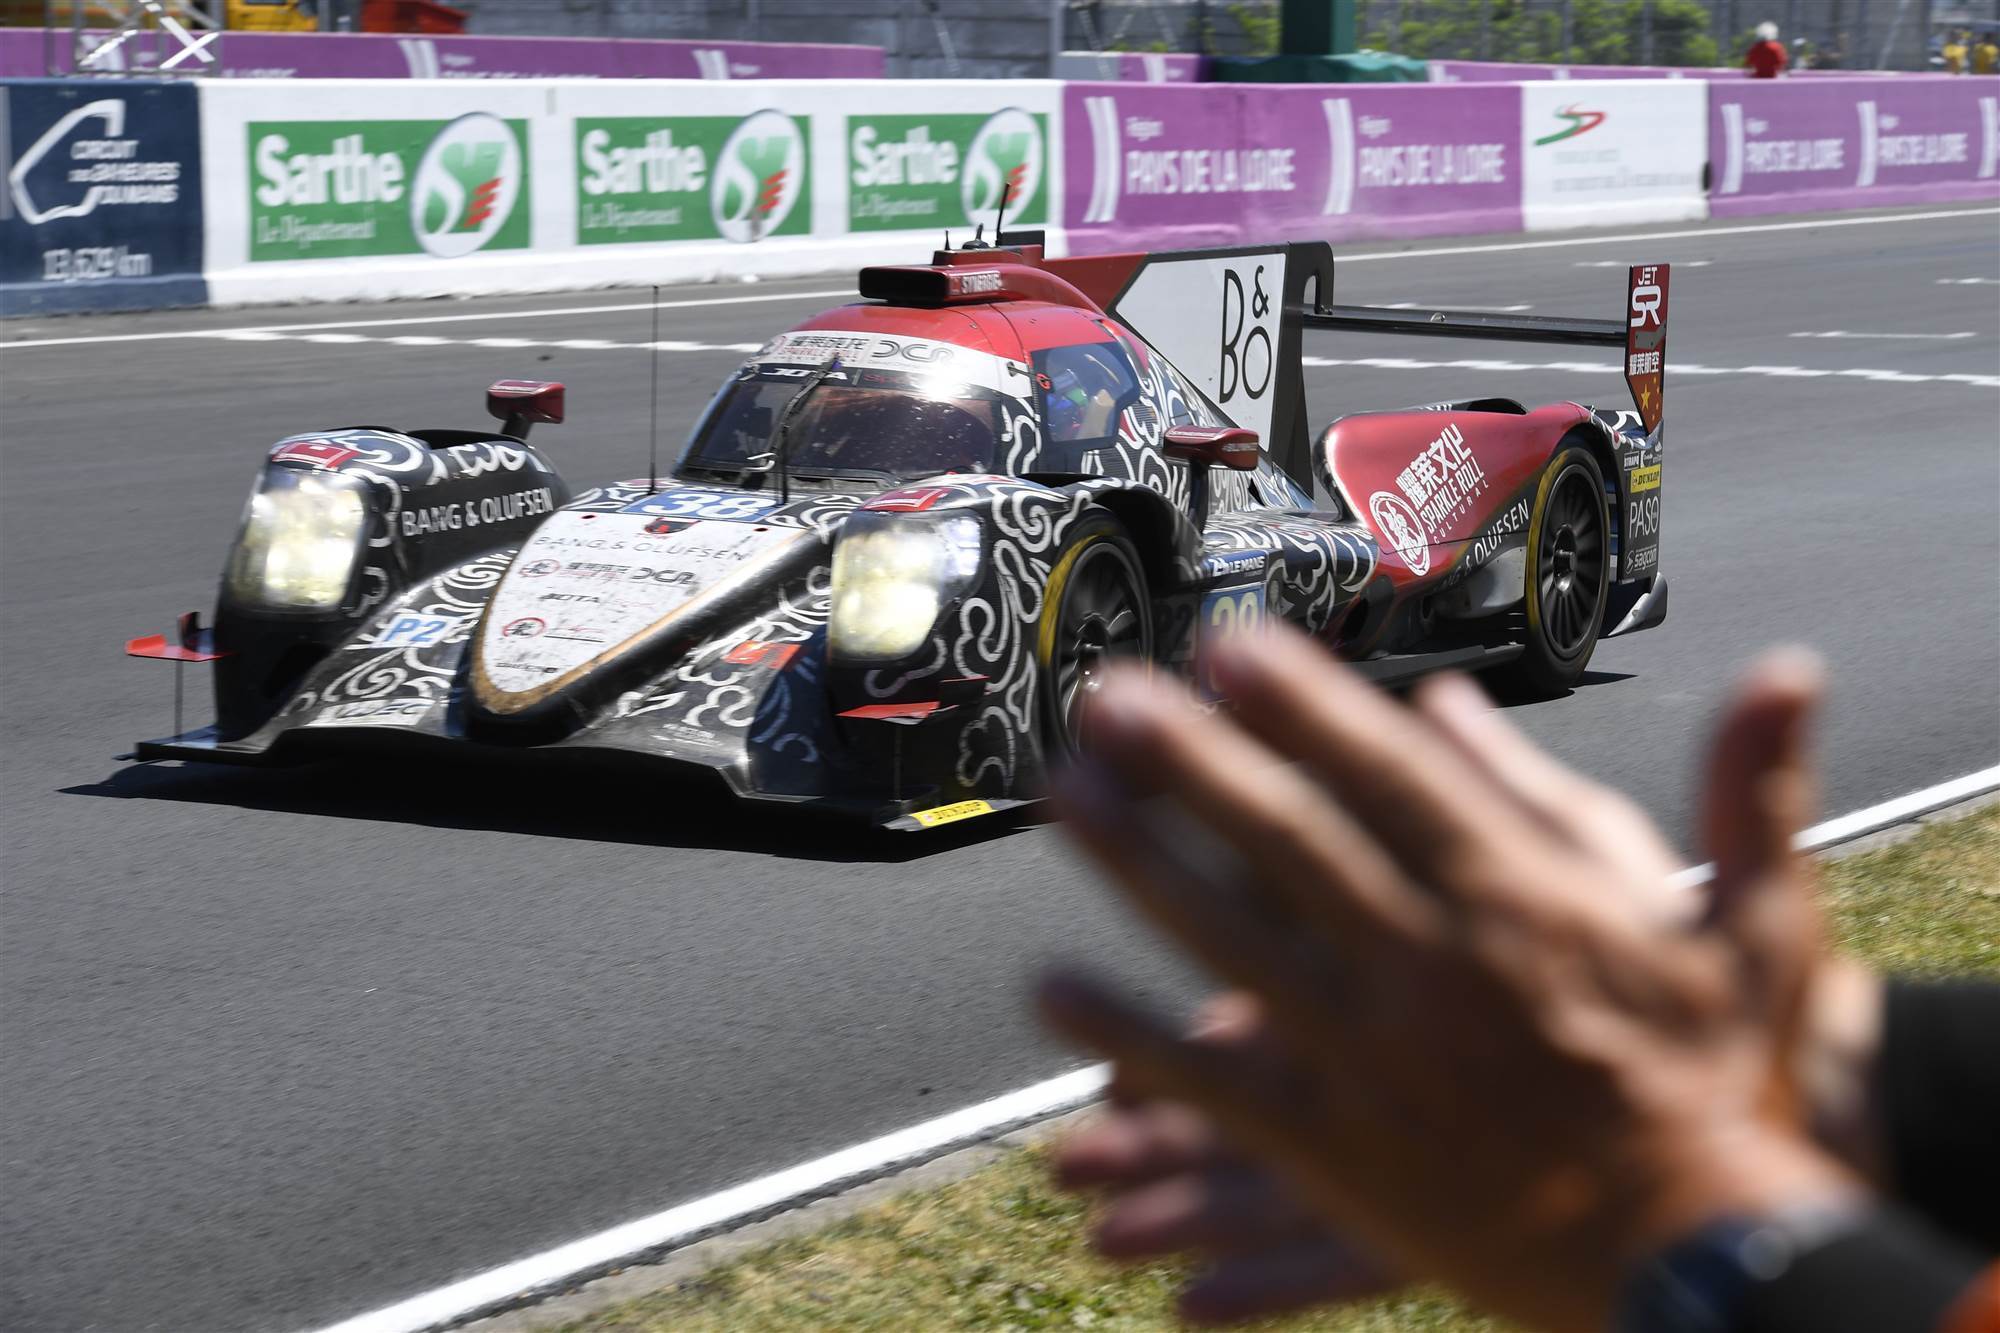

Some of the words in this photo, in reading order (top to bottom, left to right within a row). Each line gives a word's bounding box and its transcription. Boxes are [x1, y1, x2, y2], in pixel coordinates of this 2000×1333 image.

[255, 133, 405, 207] Sarthe
[582, 129, 706, 195] Sarthe
[851, 126, 958, 187] Sarthe
[1126, 149, 1179, 195] PAYS
[1181, 150, 1210, 193] DE
[1212, 149, 1238, 192] LA
[1240, 148, 1296, 191] LOIRE
[1359, 146, 1404, 187] PAYS
[1406, 145, 1430, 185] DE
[1431, 144, 1454, 184] LA
[1456, 143, 1505, 184] LOIRE
[1637, 266, 1658, 286] JET
[1630, 285, 1662, 328] SR
[761, 367, 848, 381] JOA
[401, 503, 462, 537] BANG
[465, 500, 481, 527] &
[480, 486, 554, 524] OLUFSEN
[642, 492, 778, 519] 38
[1419, 478, 1463, 535] SPARKLE
[1455, 456, 1485, 496] ROLL
[1433, 479, 1489, 545] CULTURAL
[1628, 495, 1660, 540] PASO
[633, 541, 750, 562] OLUFSEN
[1474, 498, 1529, 566] OLUFSEN
[383, 617, 447, 643] P2
